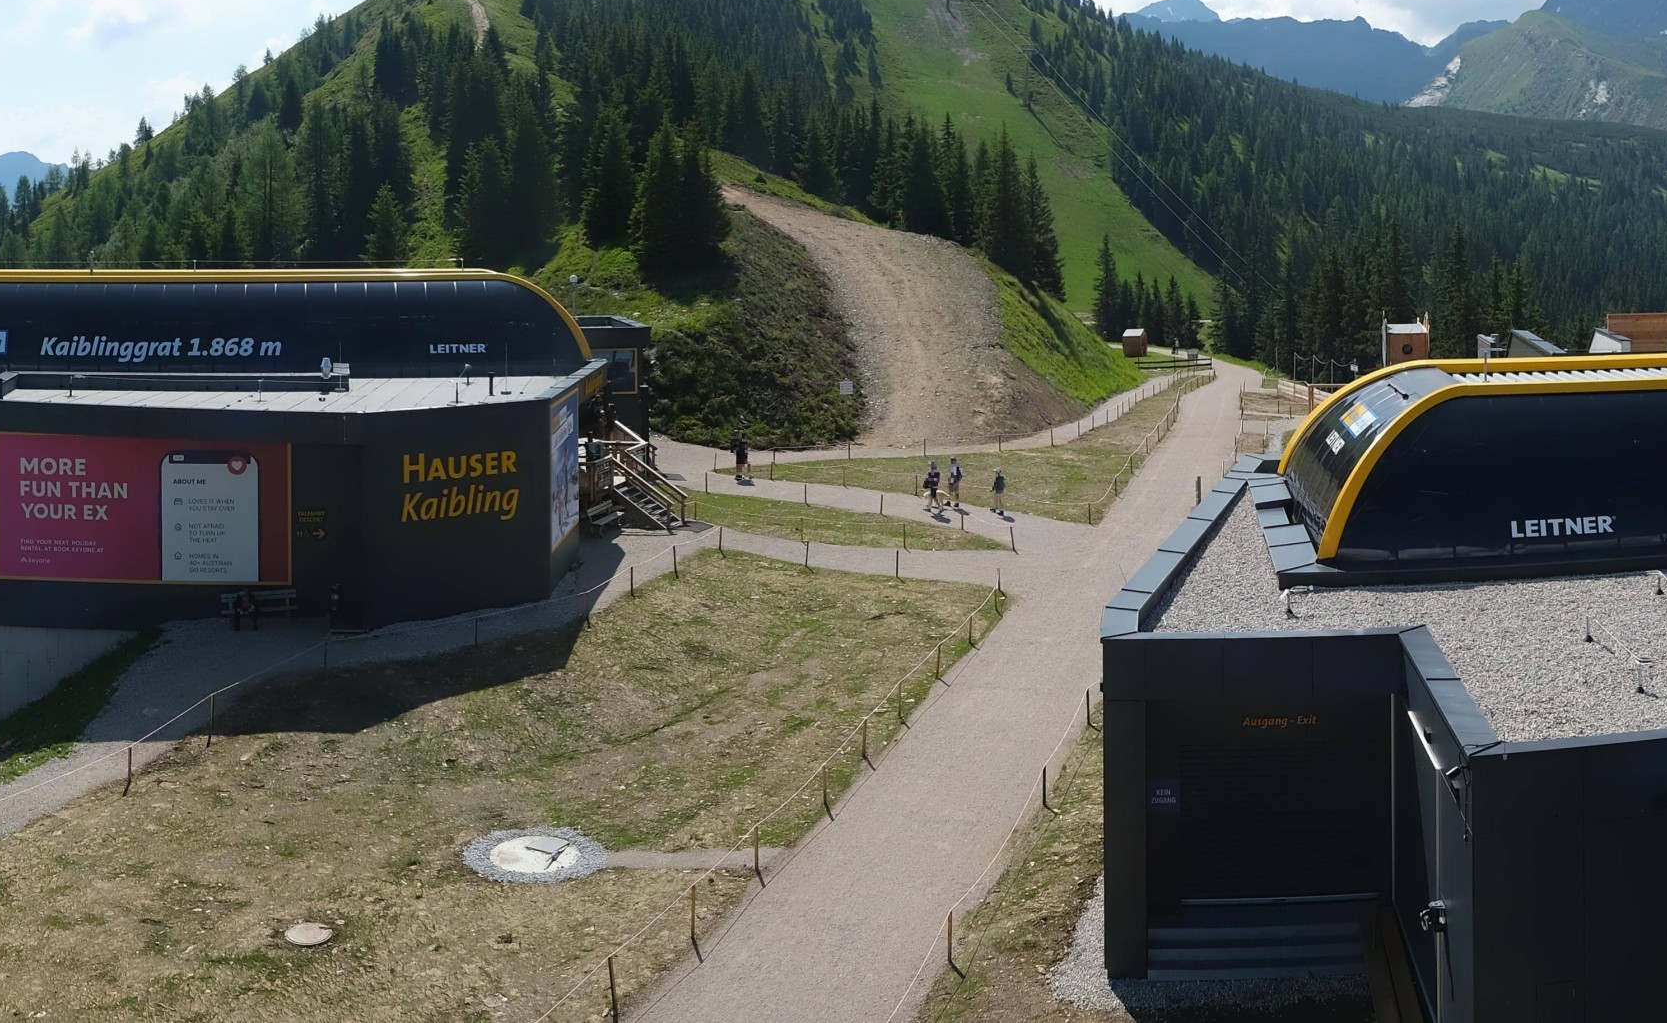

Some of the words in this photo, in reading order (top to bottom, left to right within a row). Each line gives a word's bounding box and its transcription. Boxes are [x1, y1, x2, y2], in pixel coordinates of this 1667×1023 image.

[40, 336, 182, 363] Kaiblinggrat
[187, 337, 254, 356] 1.868
[259, 340, 282, 356] m
[429, 343, 487, 354] LEITNER
[20, 457, 87, 476] MORE
[403, 450, 517, 484] HAUSER
[20, 480, 61, 497] FUN
[68, 481, 128, 499] THAN
[21, 502, 77, 520] YOUR
[83, 504, 108, 520] EX
[401, 484, 520, 523] Kaibling
[1243, 717, 1288, 728] Ausgang
[1297, 715, 1317, 725] Exit
